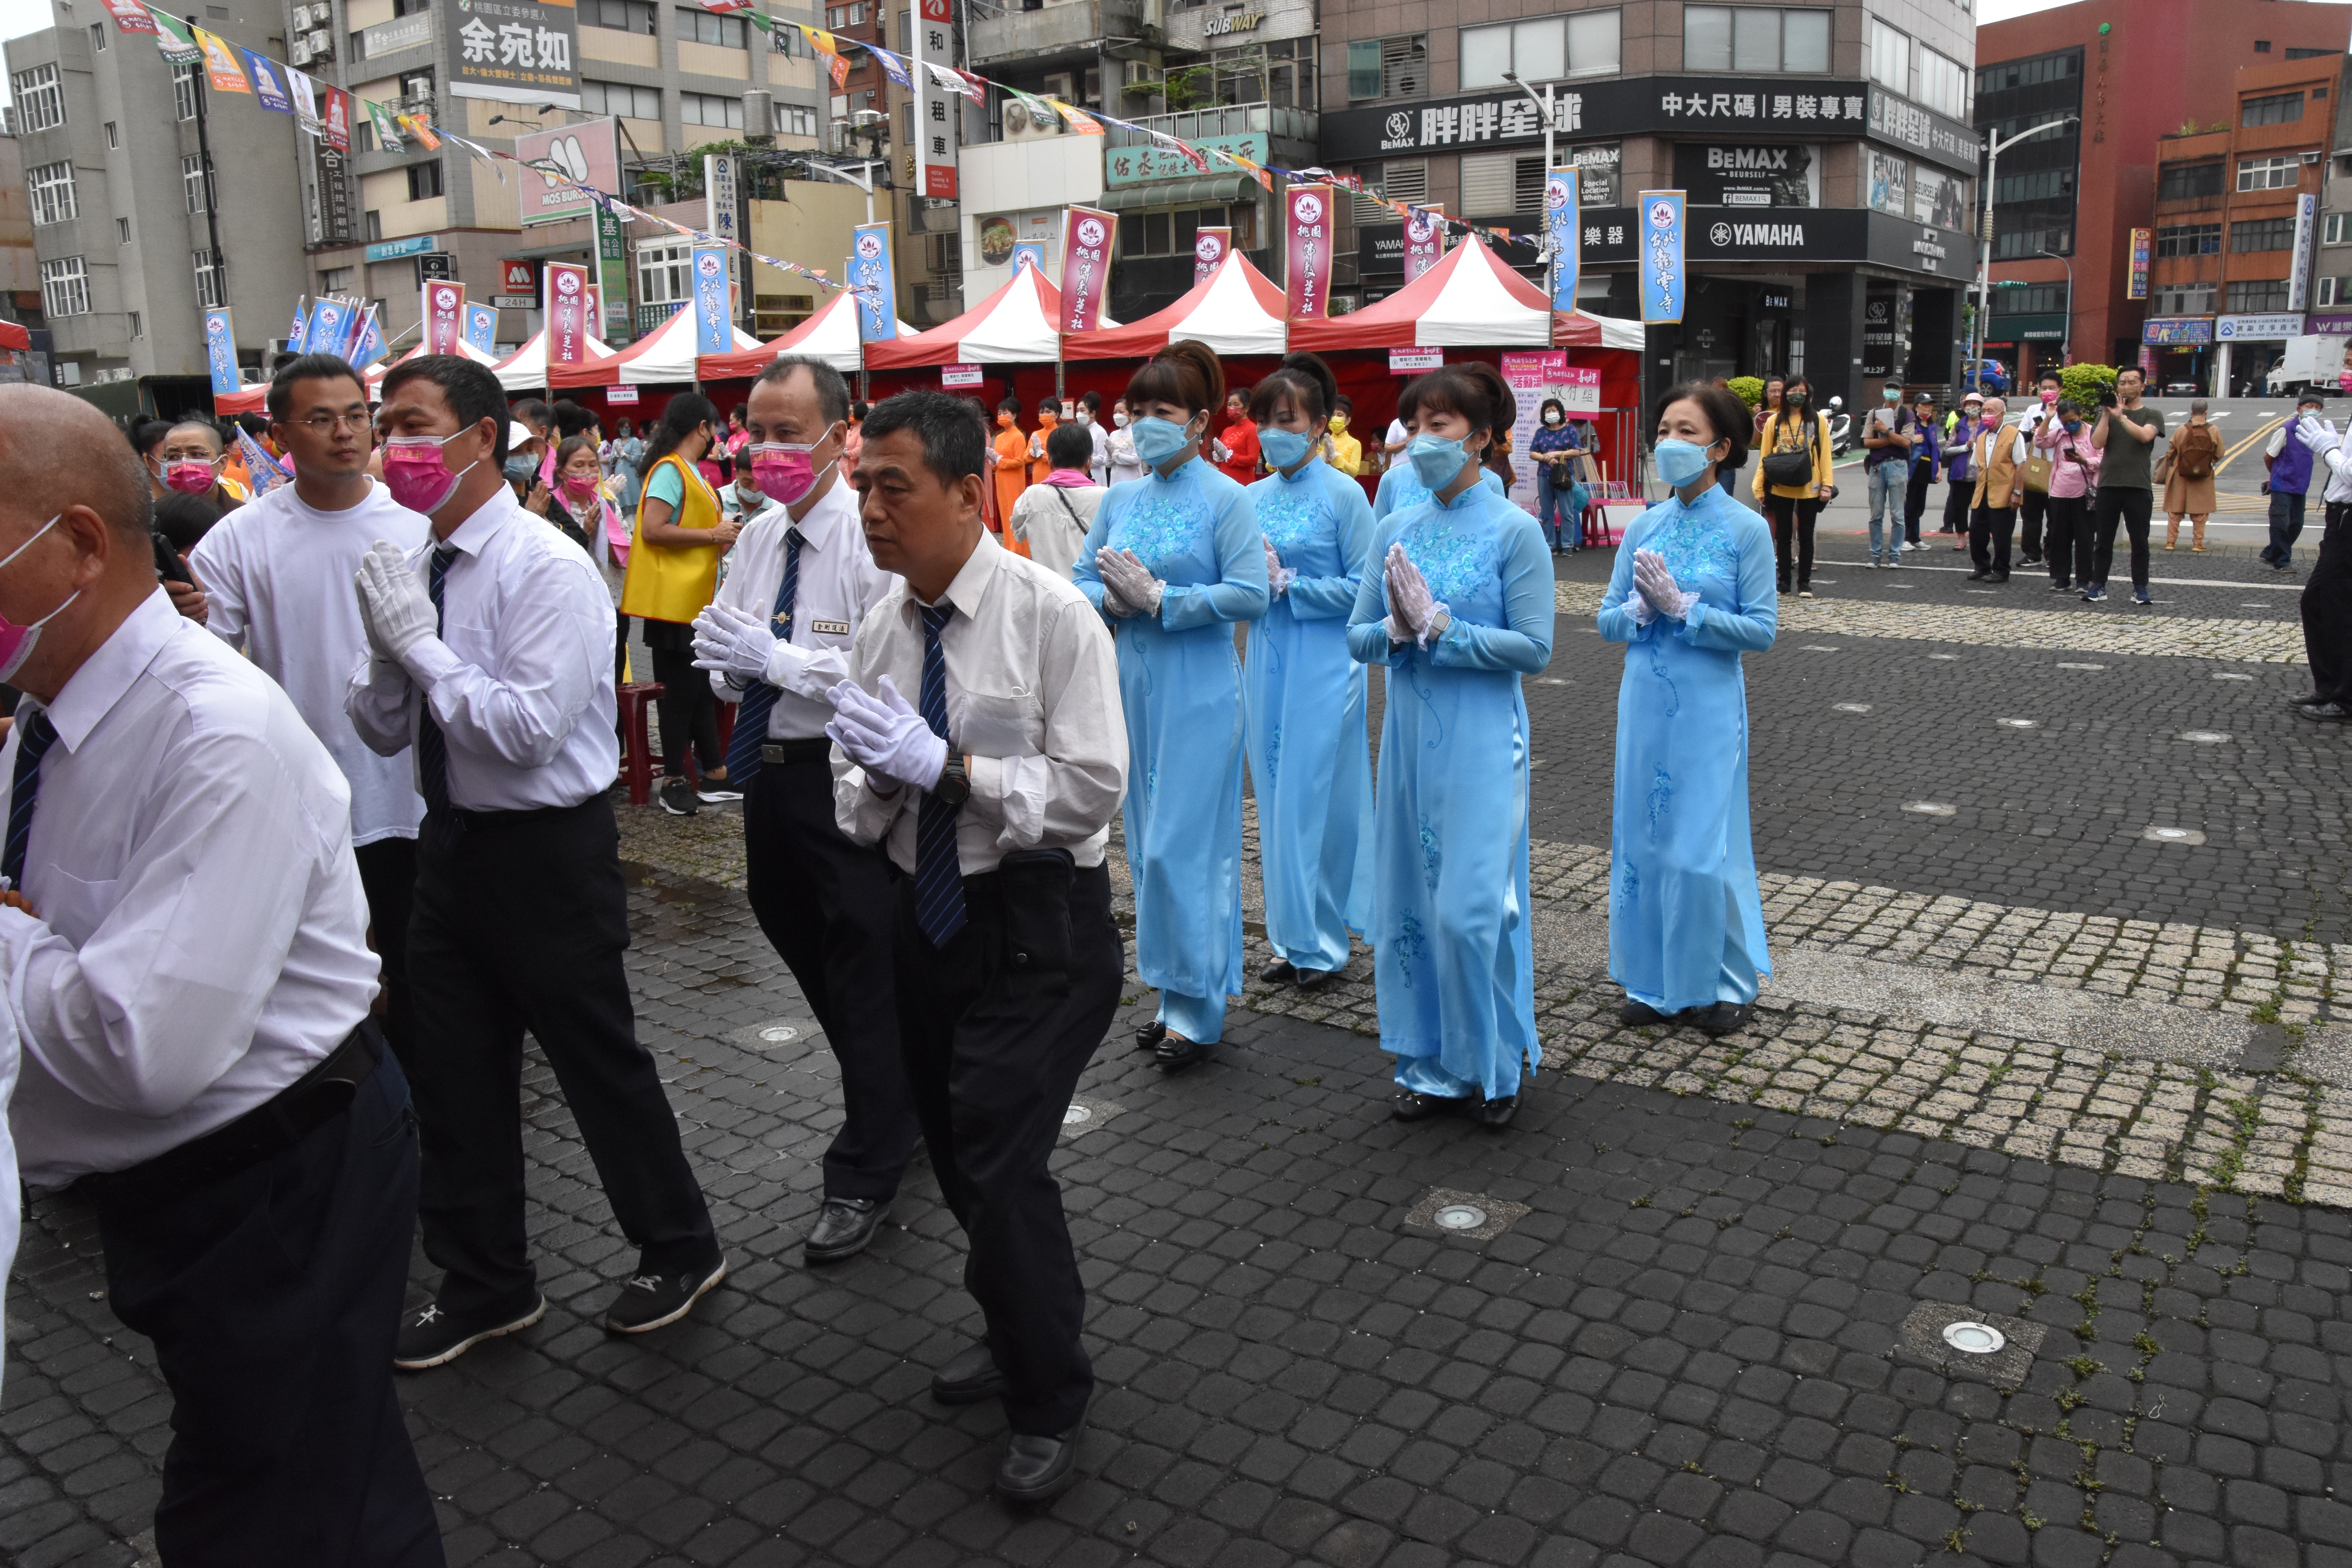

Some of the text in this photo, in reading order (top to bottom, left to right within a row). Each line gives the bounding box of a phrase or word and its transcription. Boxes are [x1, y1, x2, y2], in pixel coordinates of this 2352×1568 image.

[474, 2, 548, 21] 桃園區立委參選人
[1203, 12, 1264, 36] SUBWAY
[459, 17, 570, 71] 余宛如
[1662, 92, 1863, 120] 中大尺碼 男裝專賣
[1420, 93, 1582, 146] 胖胖星球
[1883, 96, 1931, 150] 胖胖星球
[1584, 179, 1607, 187] Special
[334, 171, 348, 238] 工程技術顧問
[542, 192, 561, 206] MOS
[1584, 226, 1623, 245] 樂器
[1733, 224, 1804, 246] YAMAHA
[505, 298, 526, 307] 24H
[1513, 375, 1543, 388] 活動流
[1550, 383, 1593, 403] 收付組
